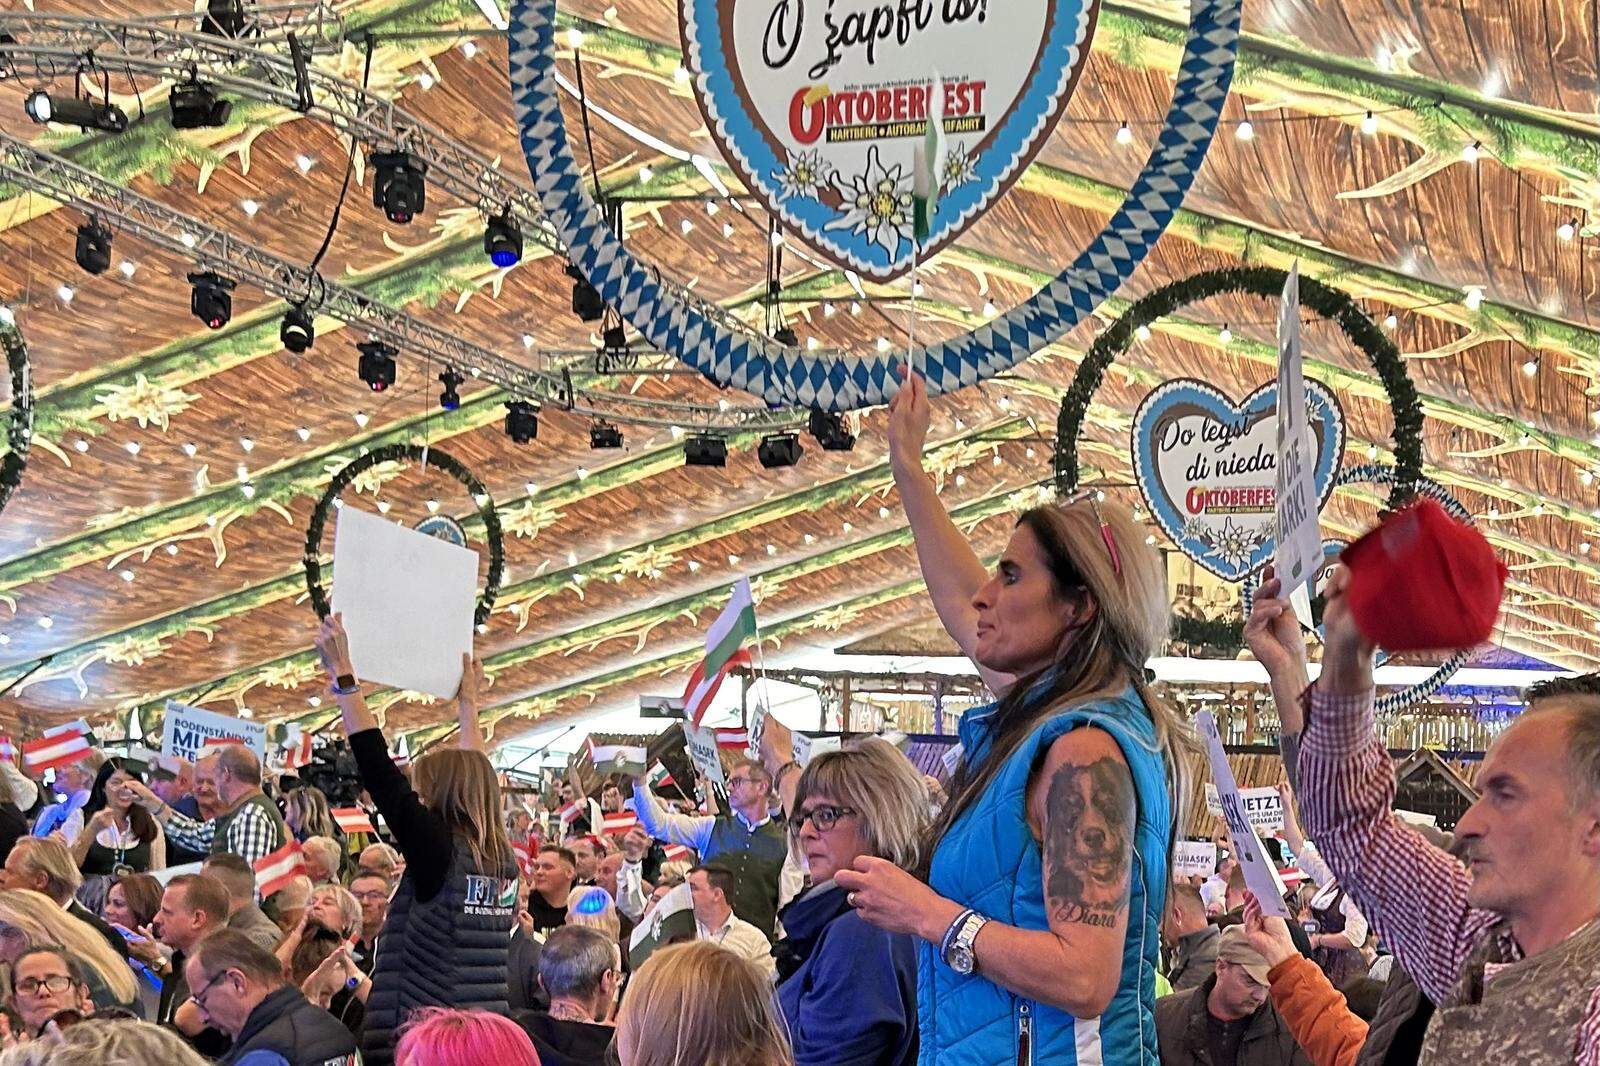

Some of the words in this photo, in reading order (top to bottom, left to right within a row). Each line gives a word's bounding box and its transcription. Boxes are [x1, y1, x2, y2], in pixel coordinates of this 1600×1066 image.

[830, 124, 878, 141] HARTBERG
[1186, 453, 1210, 482] di
[1186, 486, 1277, 515] OKTOBERFES
